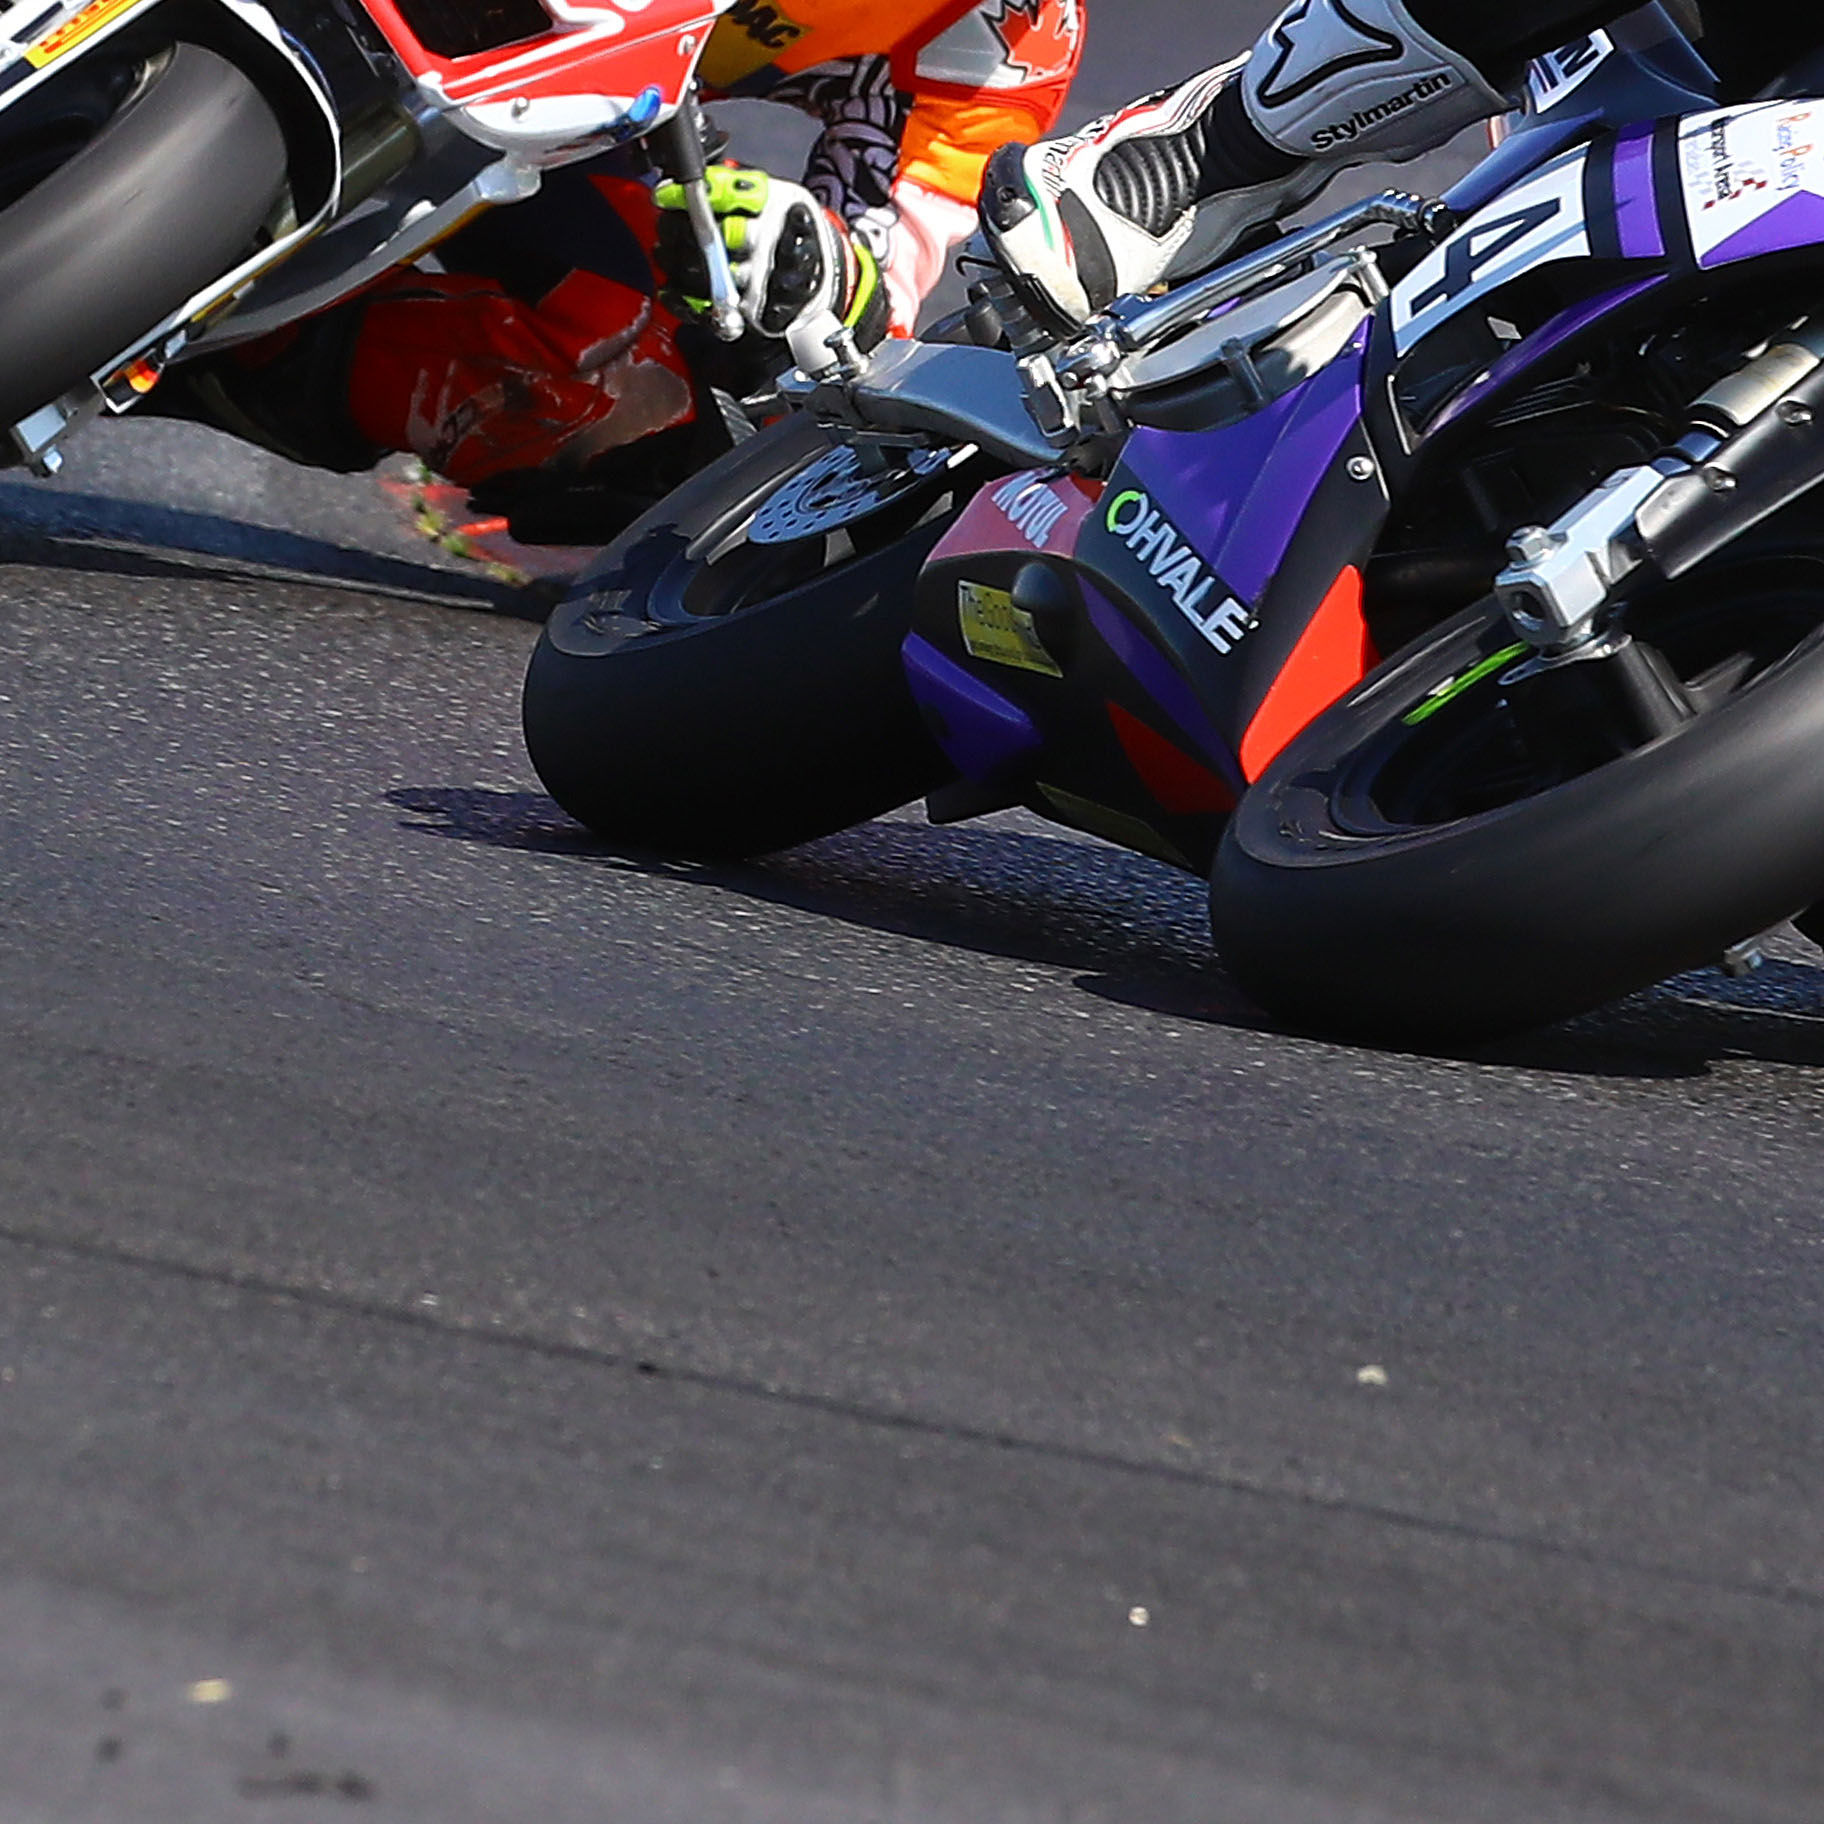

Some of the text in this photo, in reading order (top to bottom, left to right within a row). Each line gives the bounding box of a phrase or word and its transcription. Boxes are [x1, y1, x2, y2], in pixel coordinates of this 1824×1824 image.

[1310, 72, 1451, 152] Stylmartin
[990, 467, 1069, 546] MOTUL
[1107, 490, 1248, 655] OHVALE
